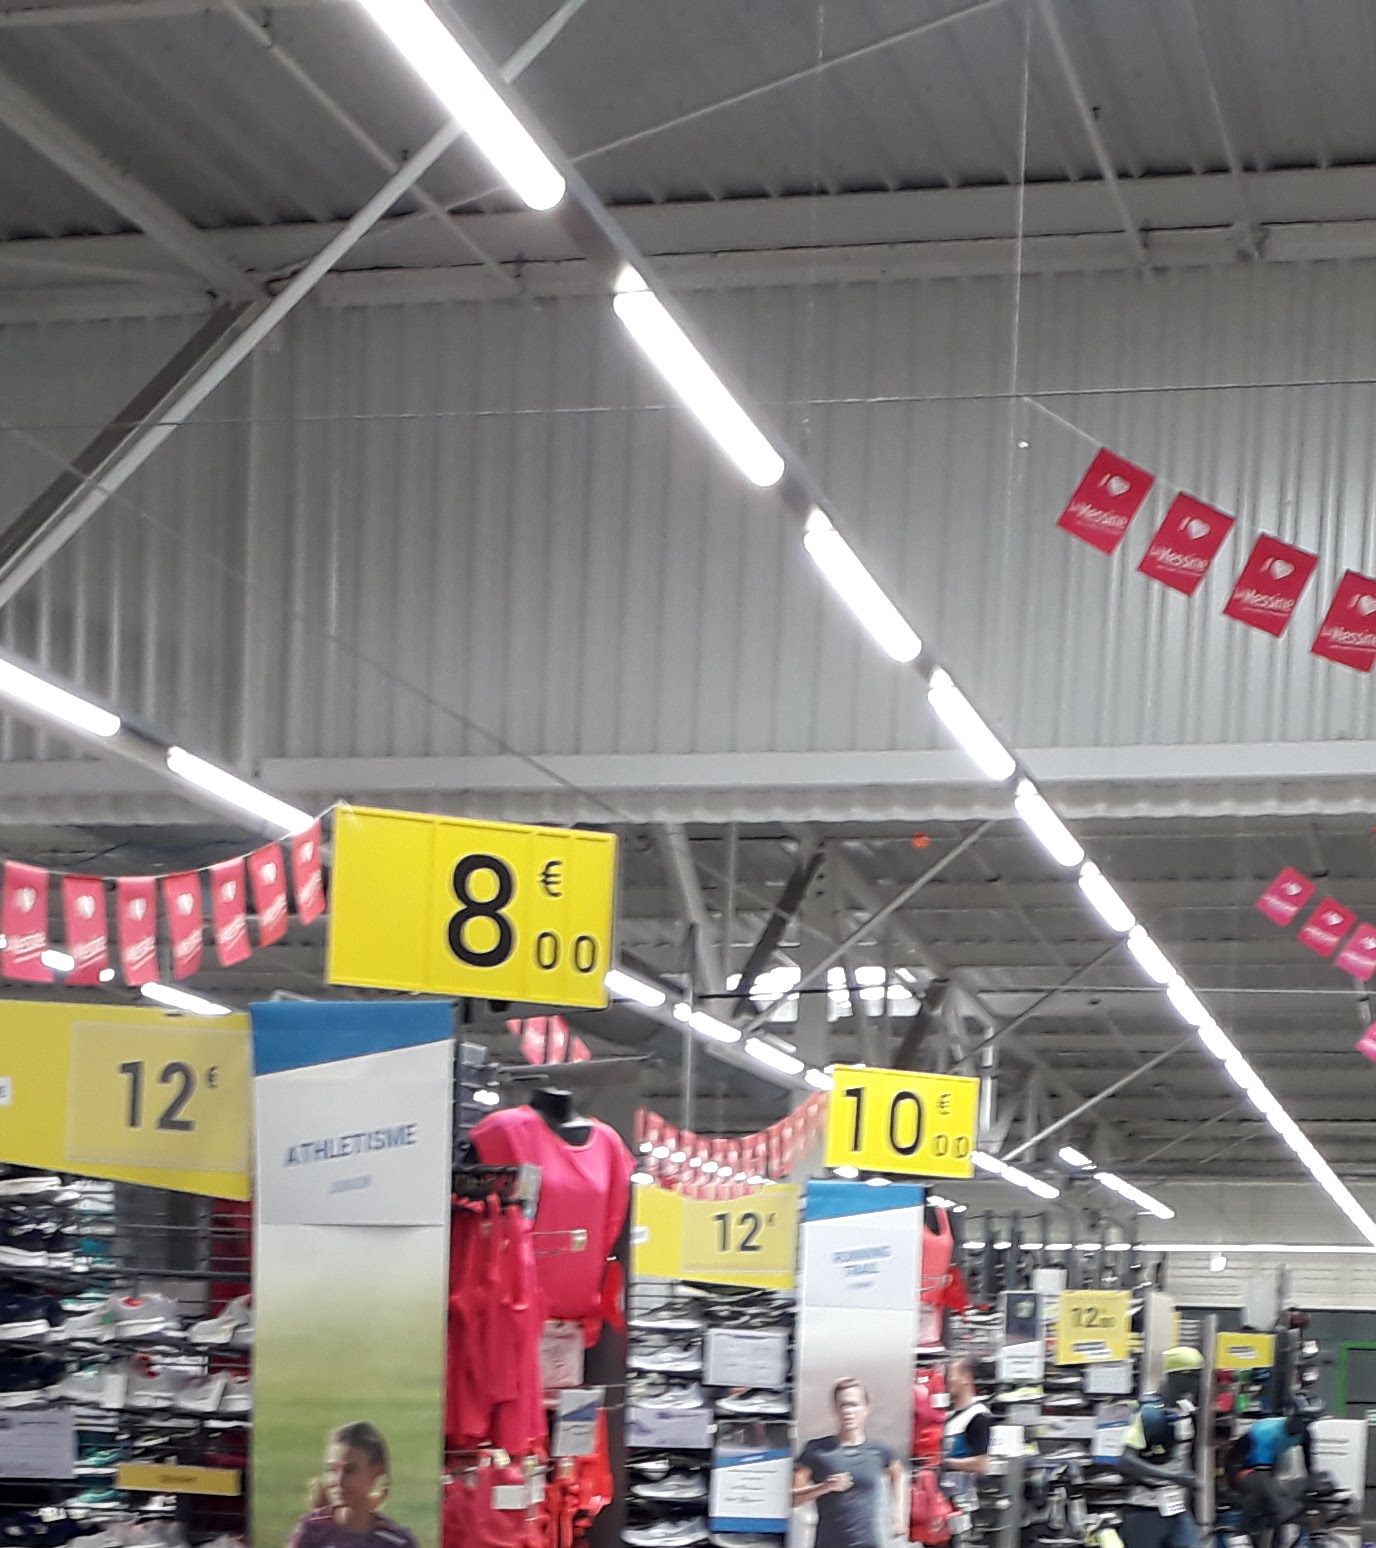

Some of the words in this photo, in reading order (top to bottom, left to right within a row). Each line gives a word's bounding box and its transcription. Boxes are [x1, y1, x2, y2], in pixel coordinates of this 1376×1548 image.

[540, 860, 563, 898] €
[448, 854, 513, 968] 8
[536, 931, 596, 974] 00
[118, 1060, 200, 1132] 12
[843, 1087, 923, 1157] 10
[284, 1122, 418, 1168] ATHLETISME
[934, 1134, 971, 1159] 00
[713, 1212, 763, 1253] 12
[1070, 1307, 1100, 1329] 12
